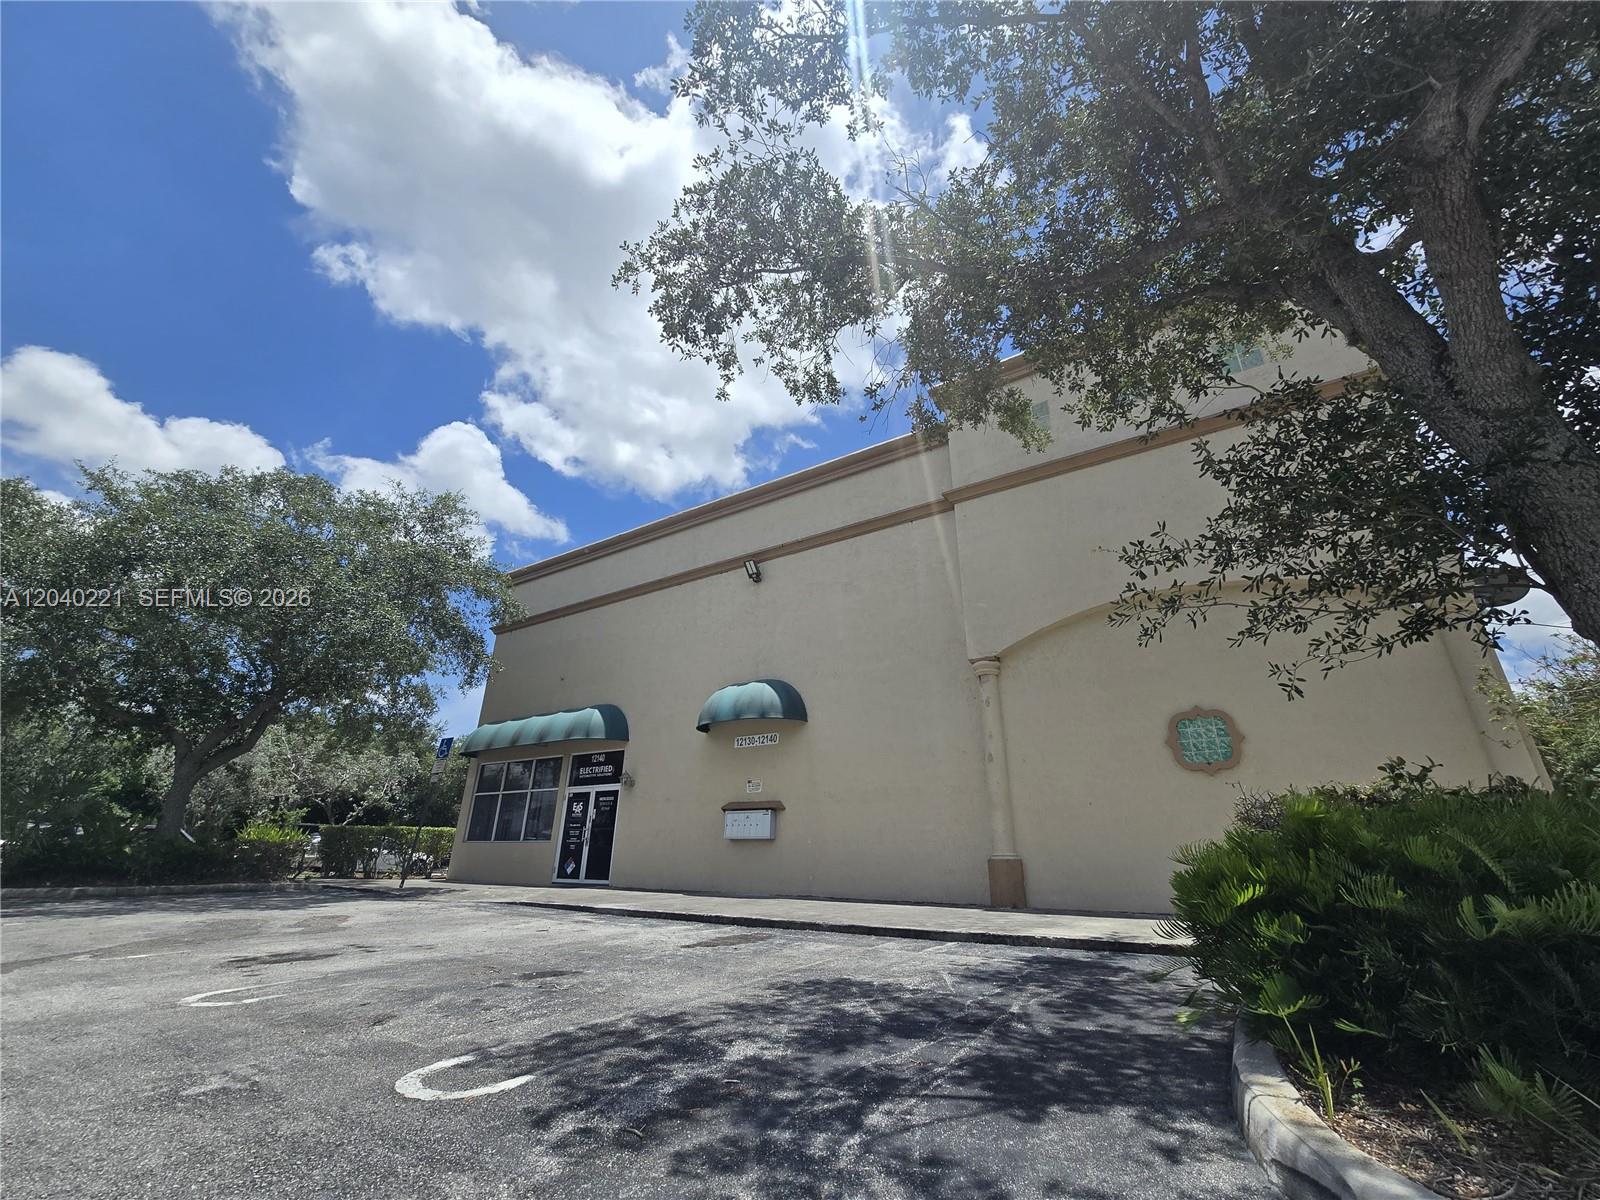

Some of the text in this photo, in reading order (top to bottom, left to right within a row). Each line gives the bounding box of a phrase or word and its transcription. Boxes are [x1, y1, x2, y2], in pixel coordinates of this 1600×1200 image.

[736, 734, 777, 746] 12130-12140
[592, 754, 605, 762] 12140
[580, 765, 613, 774] ELECTRIFIED
